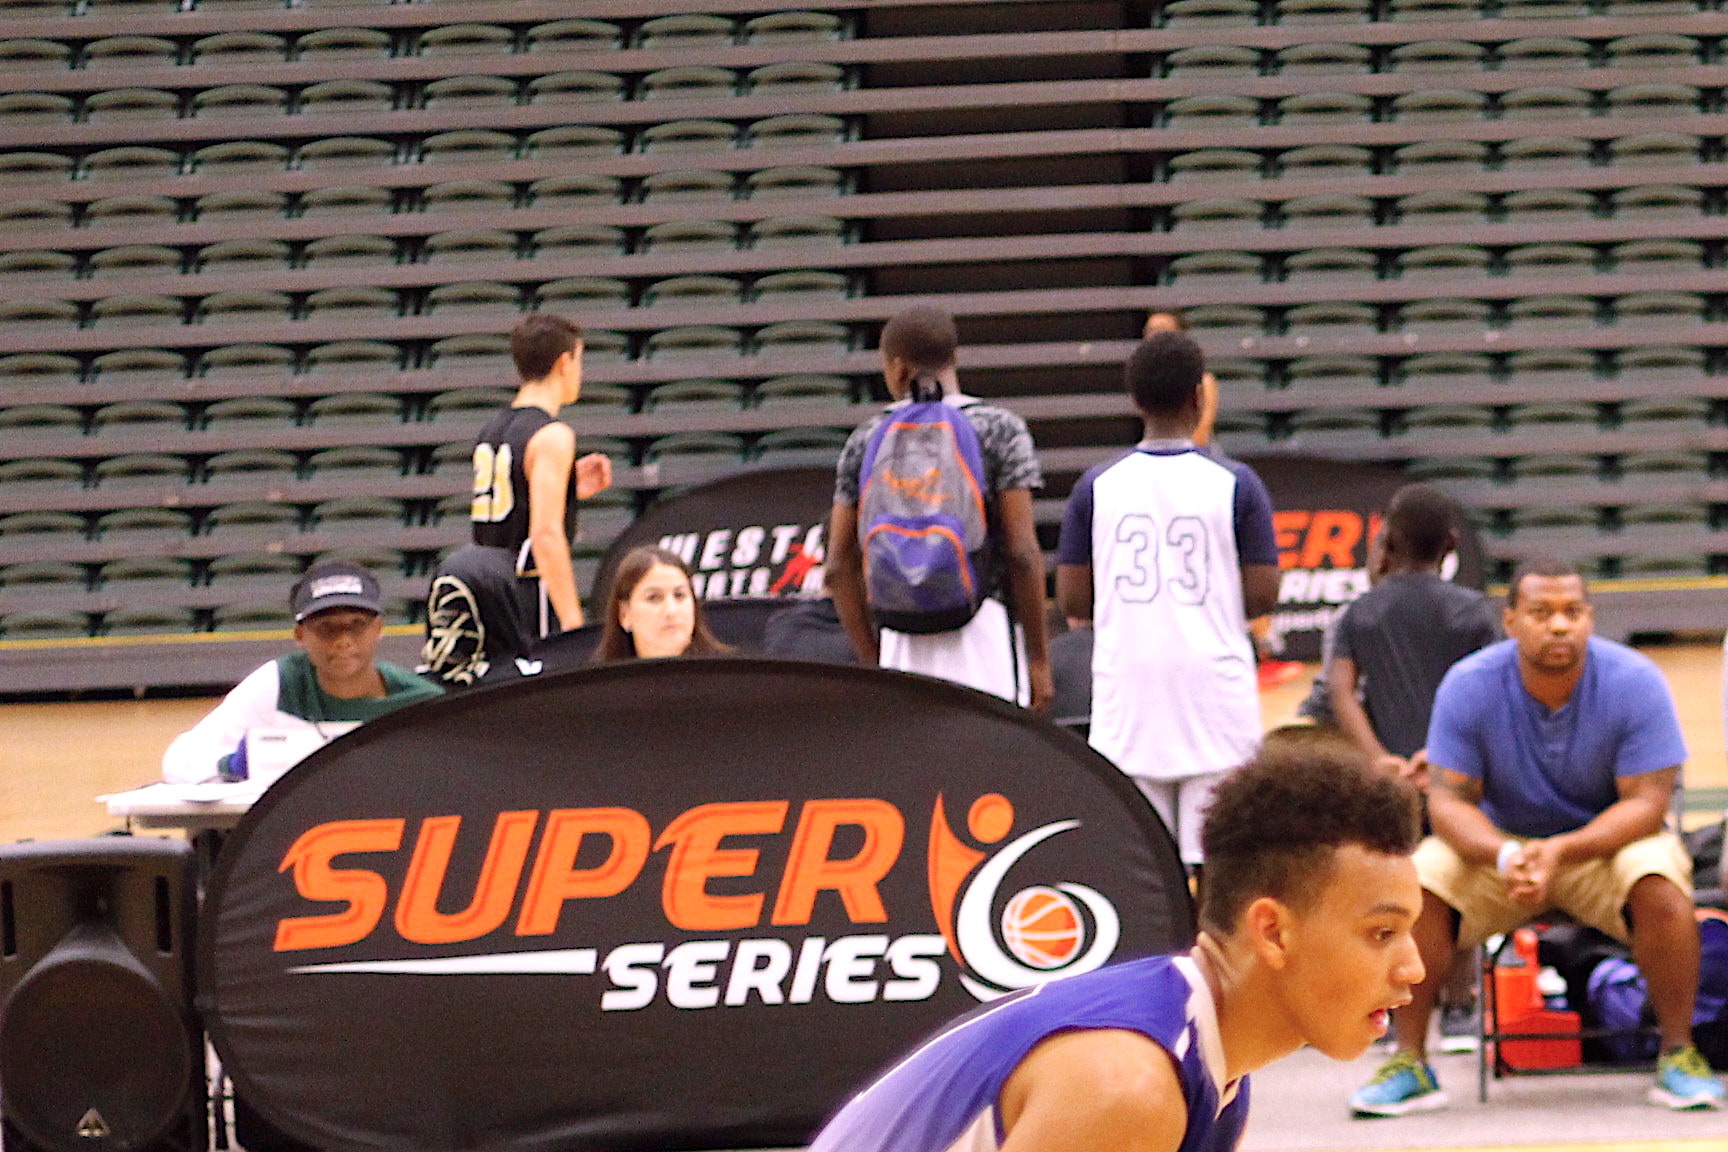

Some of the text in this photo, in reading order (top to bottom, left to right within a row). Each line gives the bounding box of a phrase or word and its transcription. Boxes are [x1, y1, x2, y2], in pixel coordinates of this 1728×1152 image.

[1114, 512, 1211, 606] 33
[273, 798, 905, 952] SUPER
[600, 933, 948, 1012] SERIES
